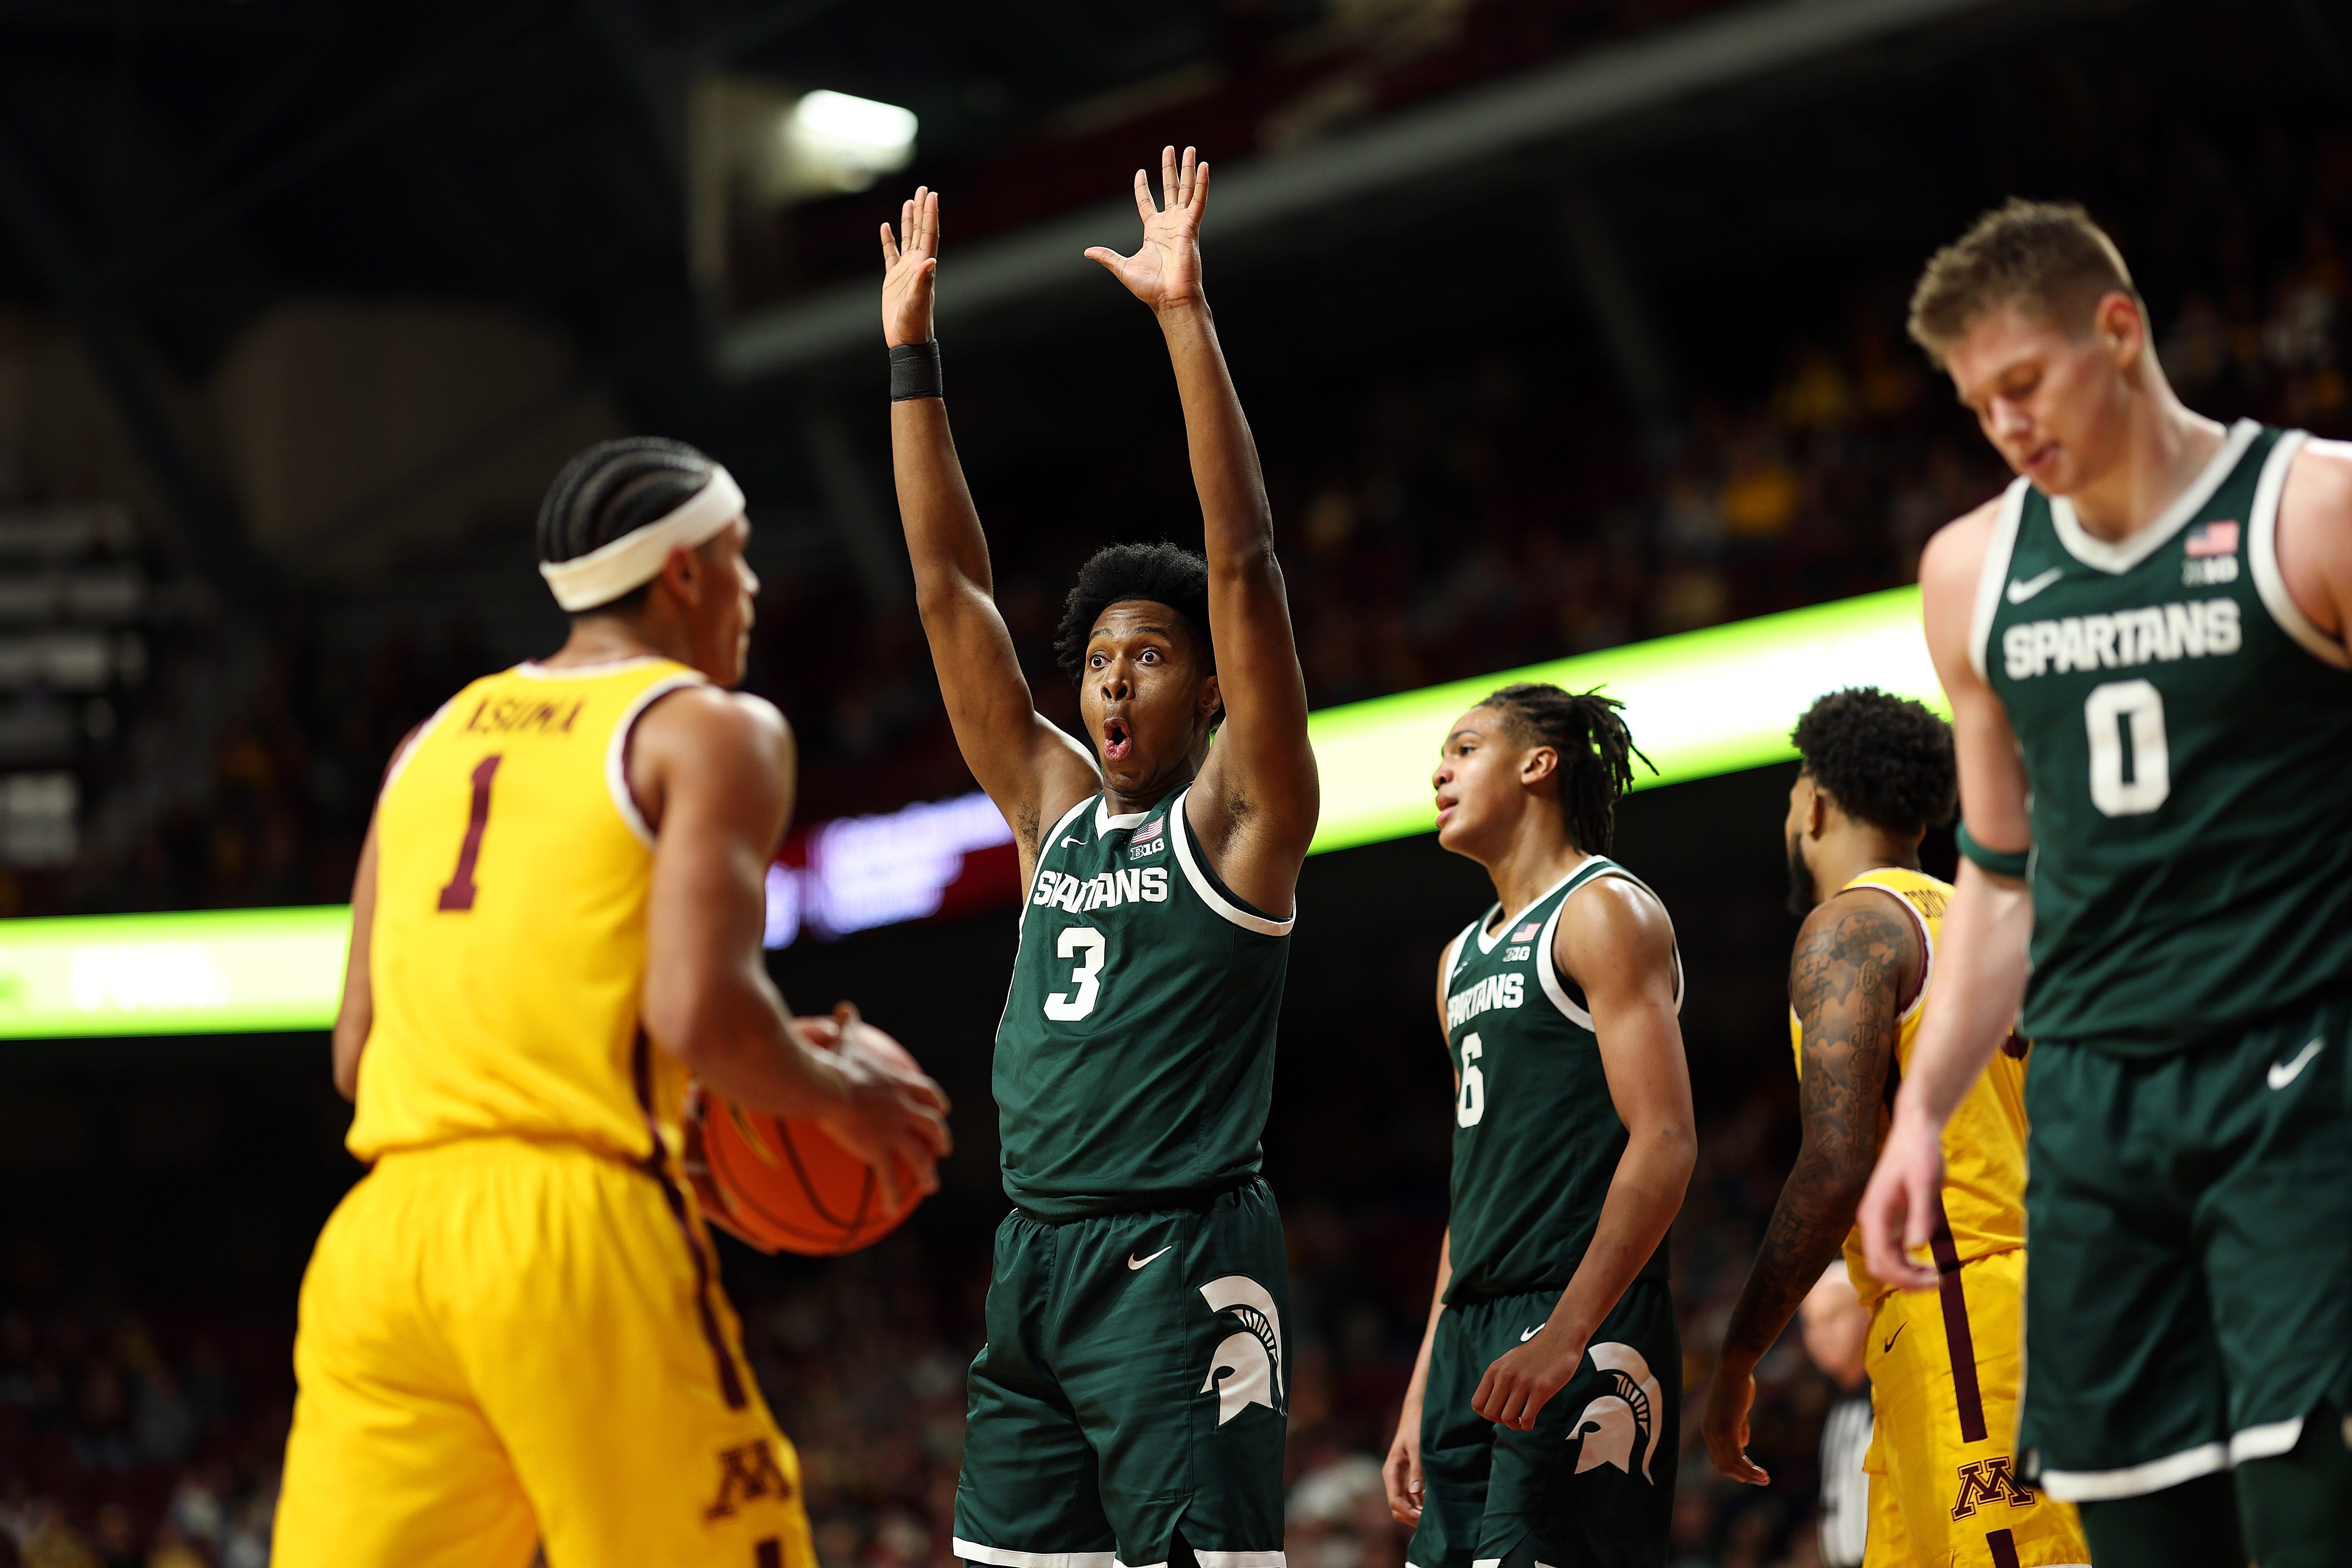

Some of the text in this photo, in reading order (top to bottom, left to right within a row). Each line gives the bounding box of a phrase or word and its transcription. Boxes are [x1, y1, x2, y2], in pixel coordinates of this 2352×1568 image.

[2002, 597, 2242, 680] SPARTANS
[2084, 678, 2170, 818] 0
[437, 754, 503, 912] 1
[1043, 927, 1105, 1022] 3
[1457, 1032, 1485, 1129] 6
[1949, 1456, 2038, 1523] M
